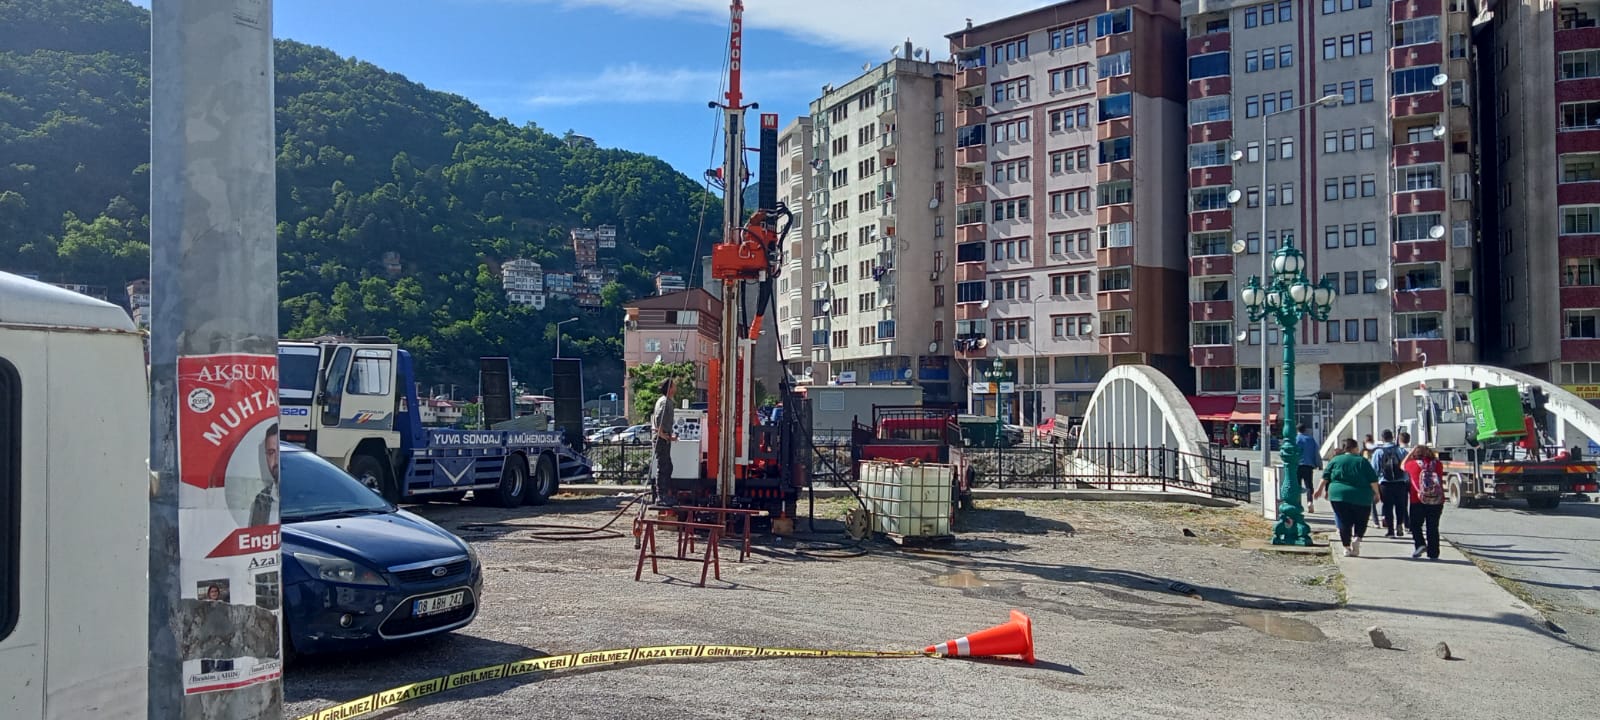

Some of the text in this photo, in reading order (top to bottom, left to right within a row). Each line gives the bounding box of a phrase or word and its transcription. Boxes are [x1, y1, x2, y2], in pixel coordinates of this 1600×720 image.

[764, 115, 775, 126] M
[198, 364, 257, 381] AKSU
[203, 388, 279, 446] MUHTA
[280, 407, 308, 416] 520
[434, 434, 461, 445] YUVA
[462, 434, 500, 445] SONDAJ
[238, 530, 280, 550] Engi
[380, 689, 410, 706] KAZA
[412, 680, 437, 698] YERİ
[452, 668, 501, 687] GİRİLMEZ
[511, 661, 541, 674] KAZA
[542, 656, 567, 670] YERİ
[581, 652, 629, 664] GİRİLMEZ
[638, 649, 667, 658] KAZA
[669, 646, 693, 656] YERİ
